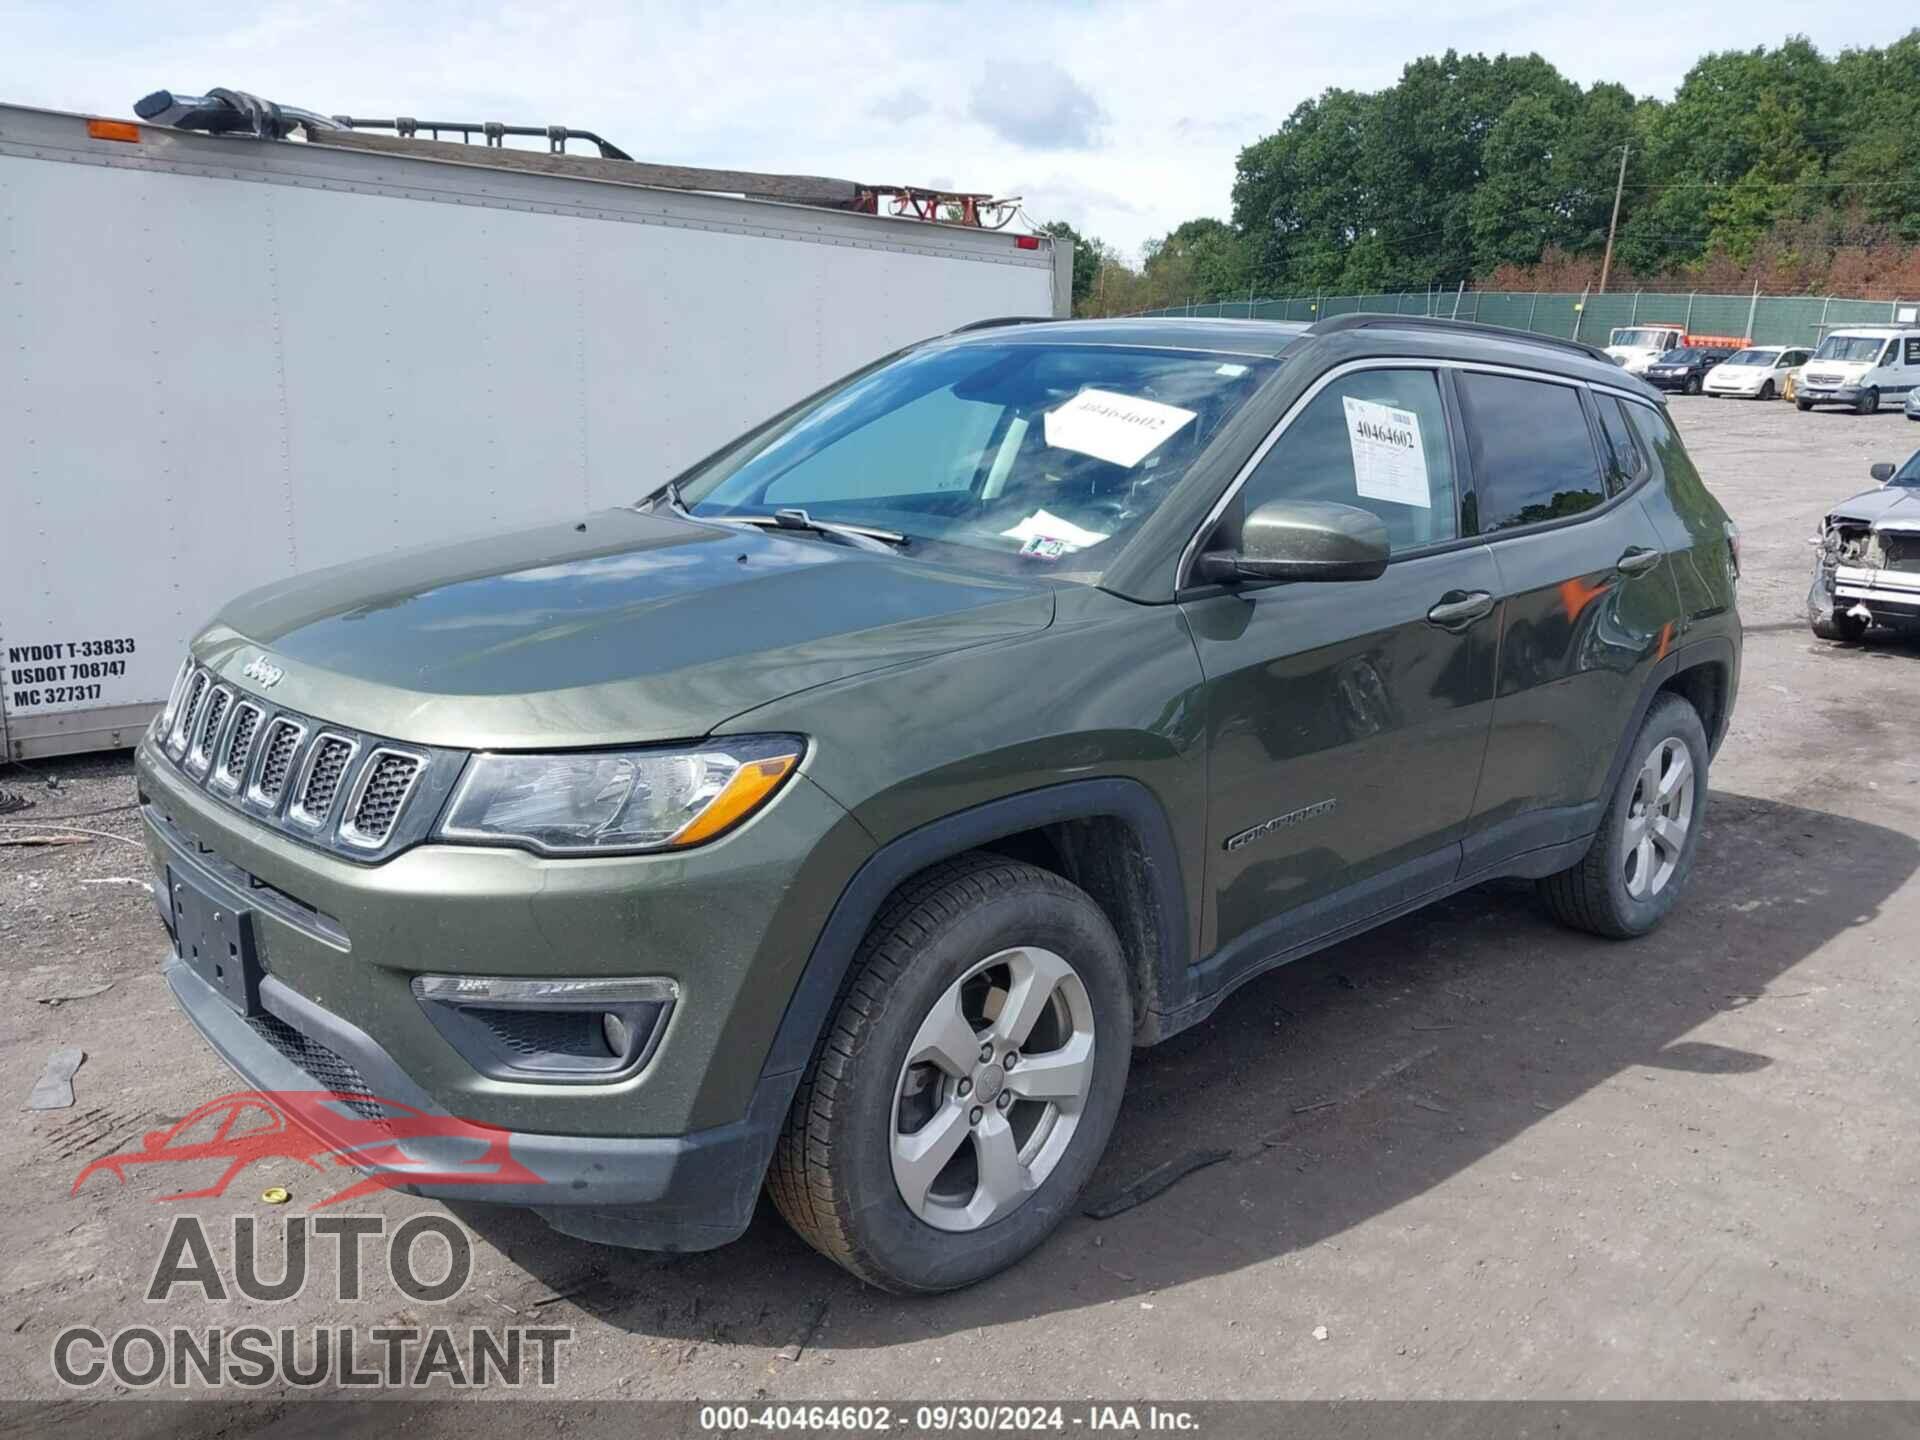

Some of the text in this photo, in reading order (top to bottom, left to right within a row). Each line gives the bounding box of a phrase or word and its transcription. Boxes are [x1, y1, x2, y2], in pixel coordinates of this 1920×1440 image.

[1356, 420, 1415, 449] 40464602
[8, 638, 136, 663] NYDOT T-33833
[11, 660, 126, 685] USDOT 708747
[242, 655, 283, 690] Jeep
[13, 683, 102, 707] MC 327317
